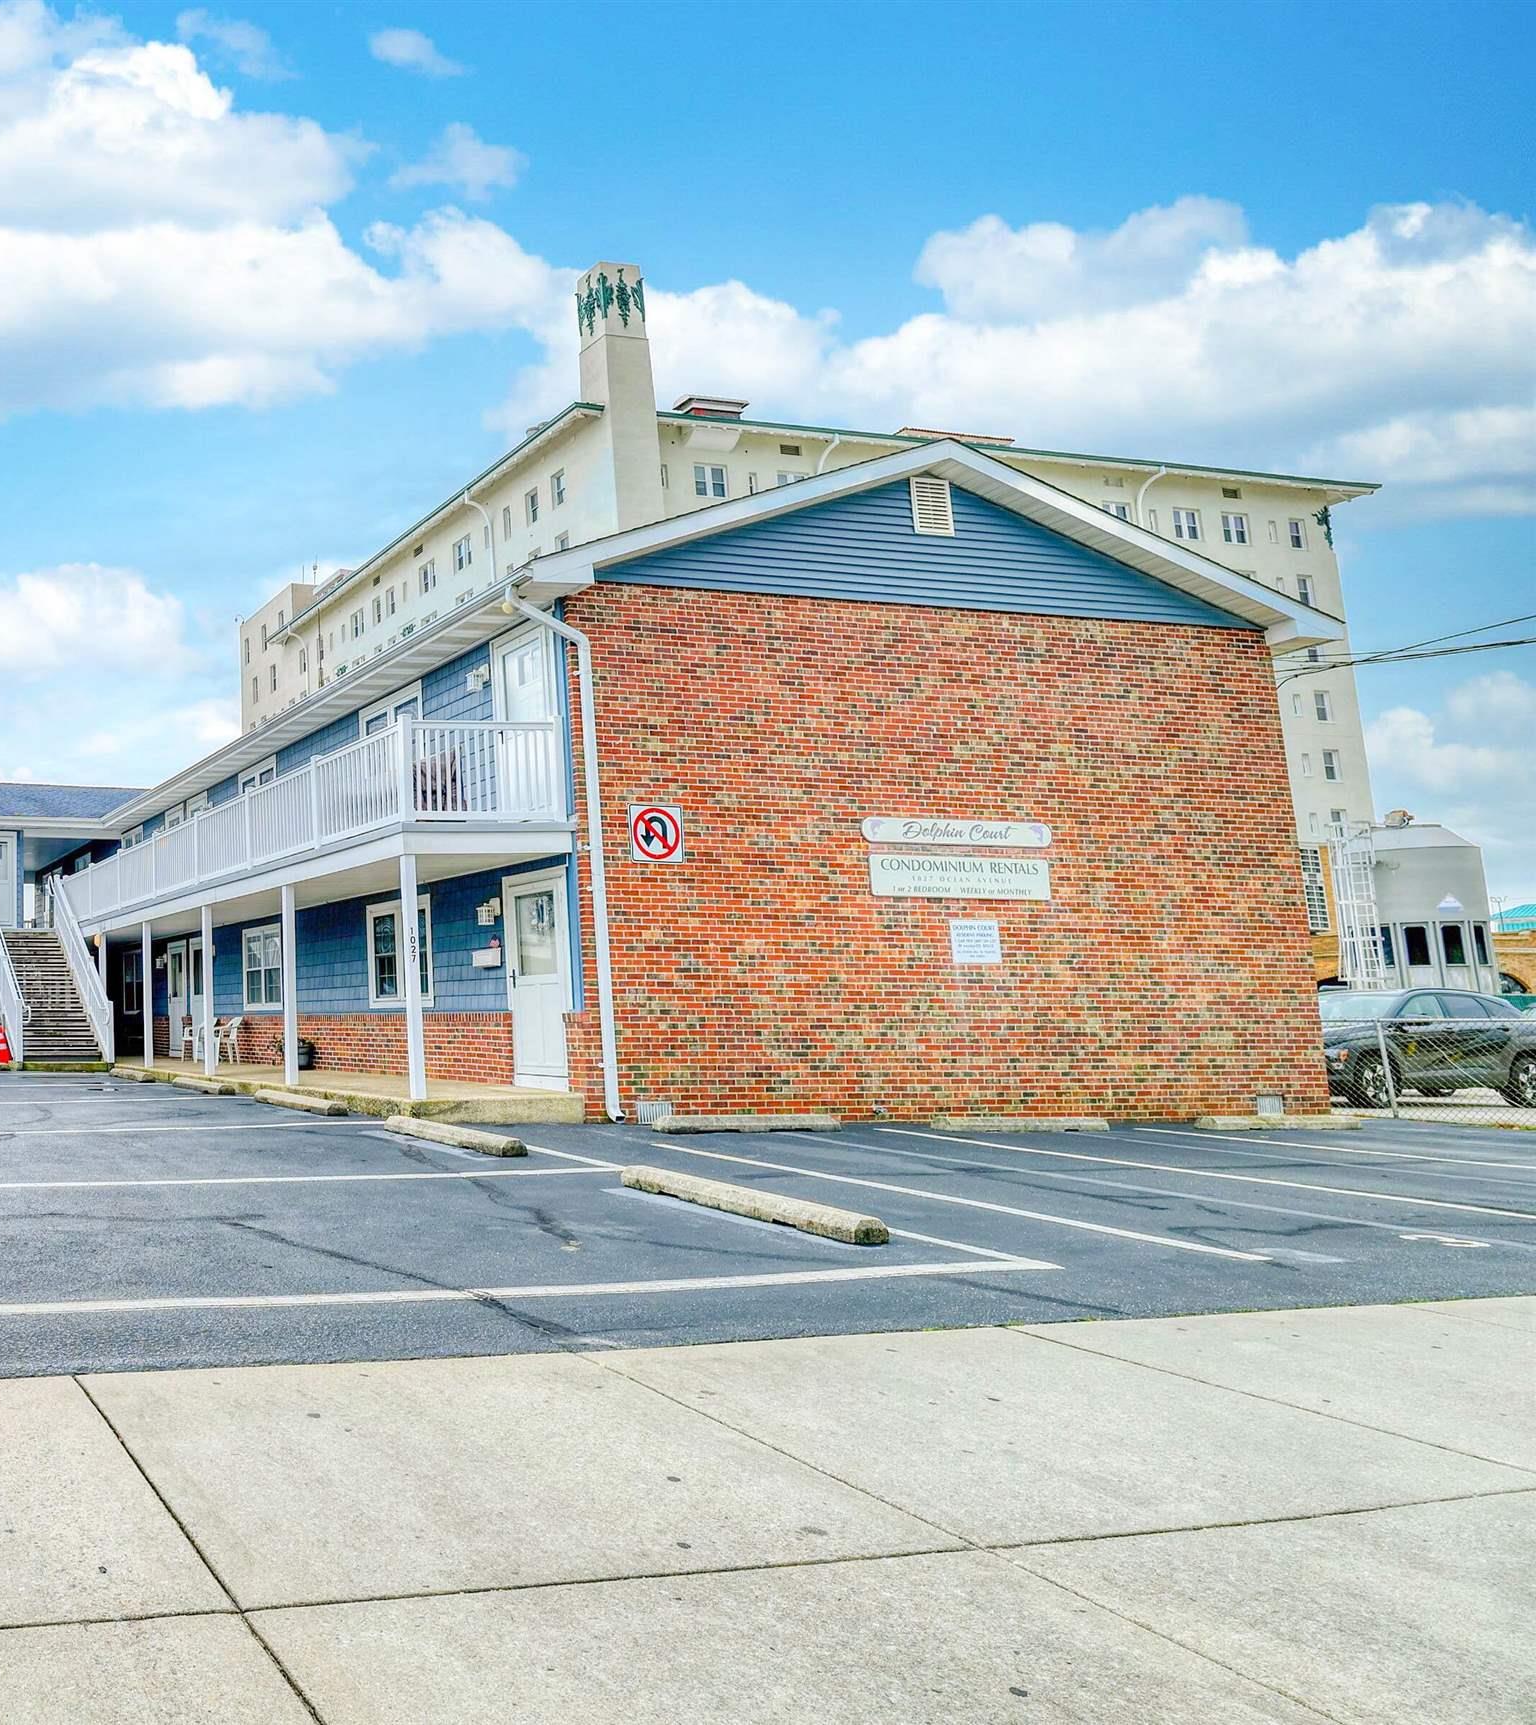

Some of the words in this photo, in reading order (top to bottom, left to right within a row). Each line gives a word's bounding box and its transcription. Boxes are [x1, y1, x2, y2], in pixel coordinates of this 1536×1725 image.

[902, 821, 966, 841] Dolphin
[969, 823, 1020, 841] Court
[880, 858, 984, 873] CONDOMINIUM
[990, 862, 1039, 875] RENTALS
[939, 875, 971, 883] OCEAN
[977, 877, 1012, 885] AVENUE
[913, 885, 951, 893] BEDROOM
[997, 888, 1032, 896] MONTHLY
